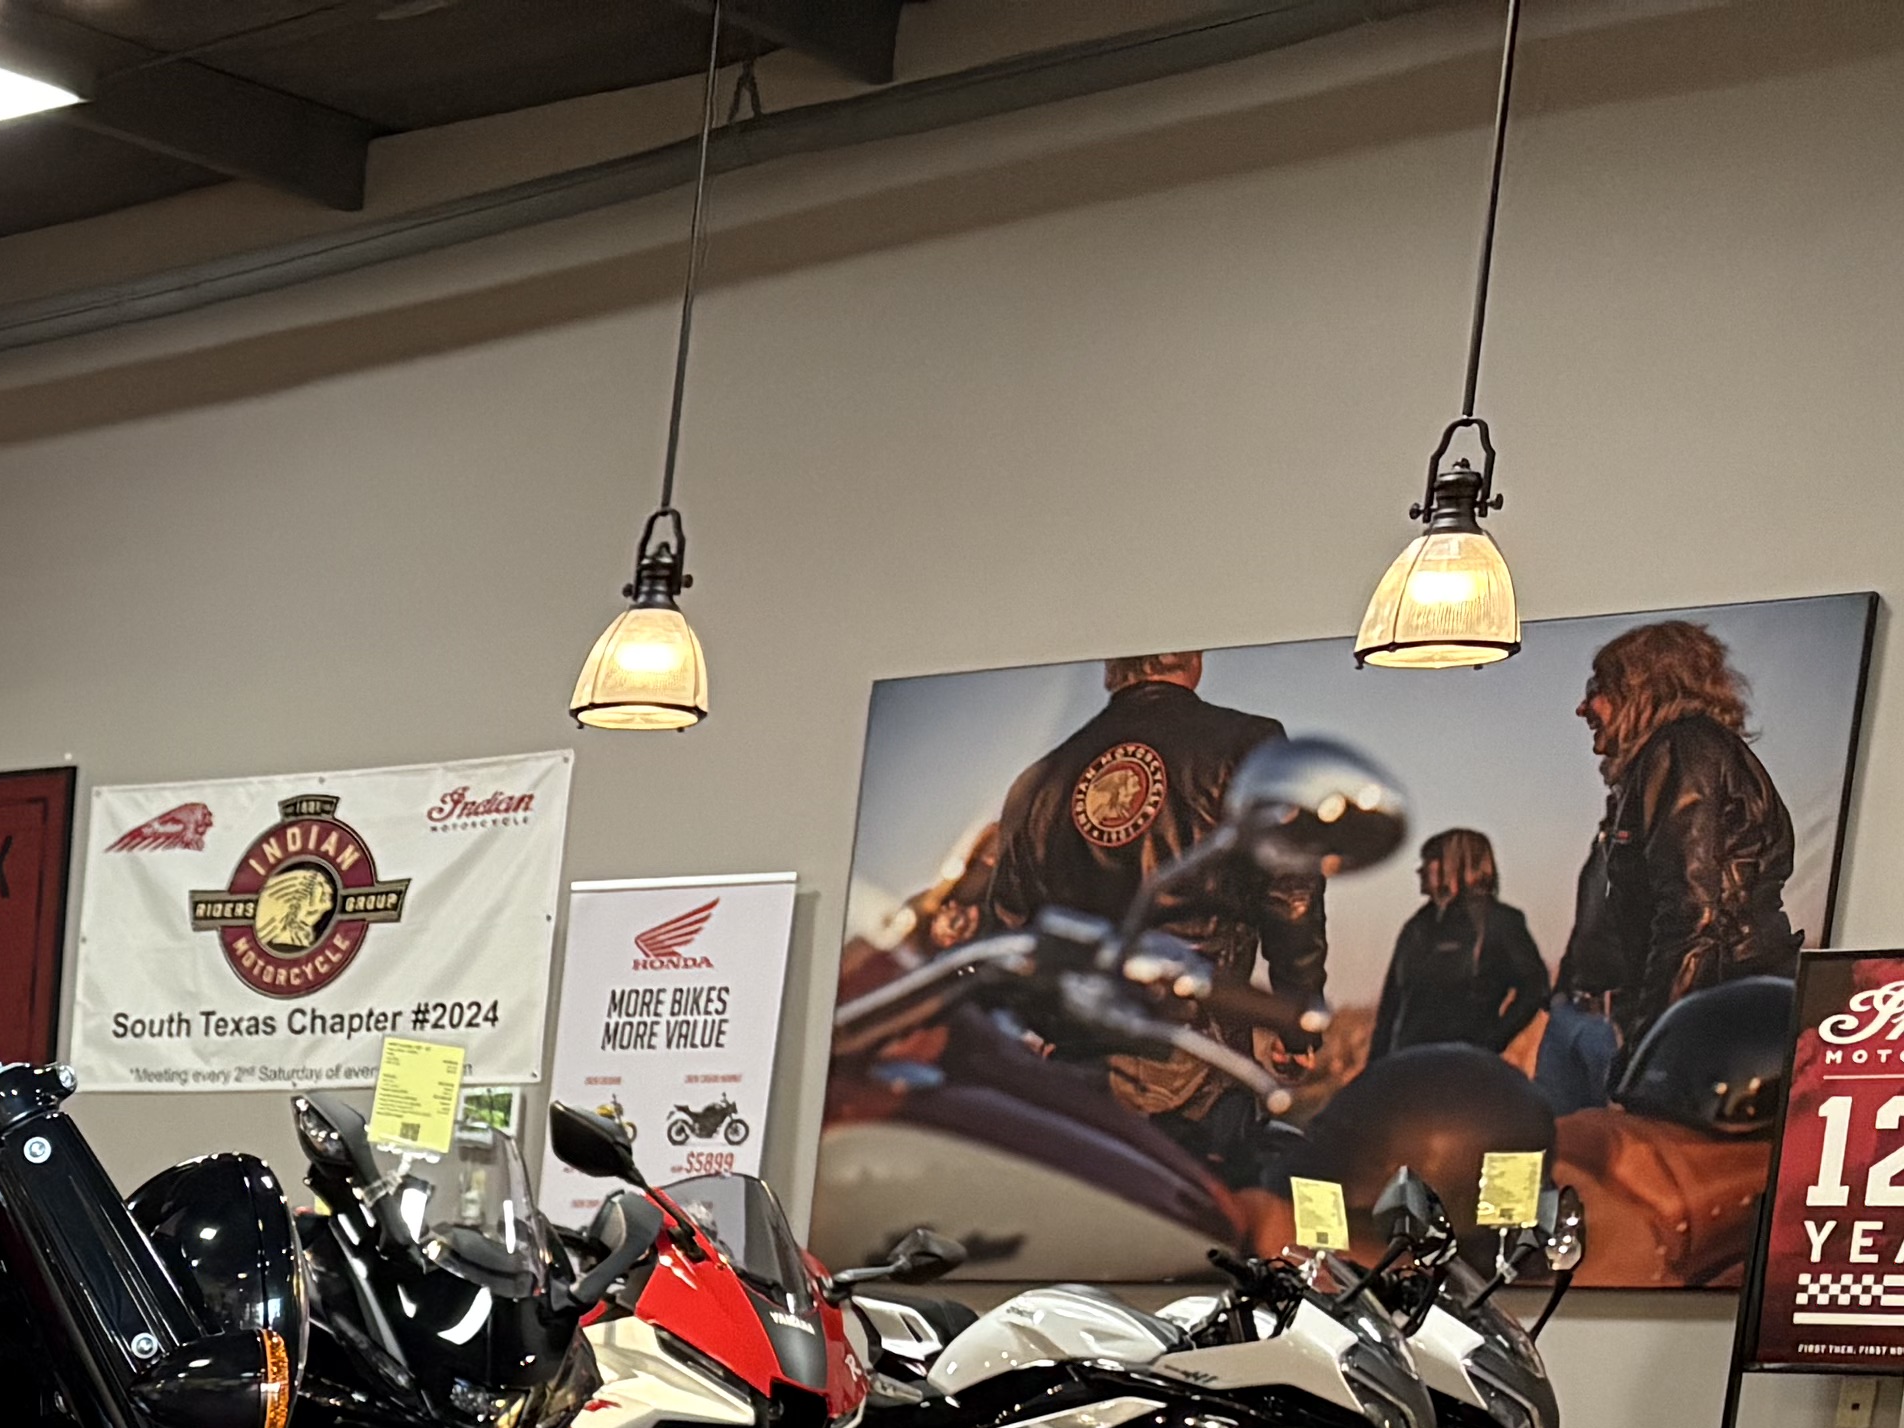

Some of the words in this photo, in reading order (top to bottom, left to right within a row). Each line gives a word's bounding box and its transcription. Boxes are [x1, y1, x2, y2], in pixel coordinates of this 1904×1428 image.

[427, 786, 534, 822] Indian
[249, 825, 361, 876] INDIAN
[195, 902, 255, 918] RIDERS
[345, 893, 398, 912] GROUP
[233, 933, 351, 986] MOTORCYCLE
[632, 956, 714, 971] HONDA
[606, 988, 667, 1019] MORE
[669, 986, 730, 1017] BIKES
[112, 1011, 192, 1039] South
[199, 1010, 277, 1036] Texas
[286, 1007, 403, 1040] Chapter
[410, 1000, 499, 1031] #2024
[601, 1021, 661, 1051] MORE
[665, 1019, 730, 1050] VALUE
[1825, 1048, 1904, 1065] MOT
[258, 1065, 323, 1083] Saturday
[325, 1063, 343, 1080] of
[685, 1151, 735, 1173] $5899
[1803, 1220, 1904, 1263] YE
